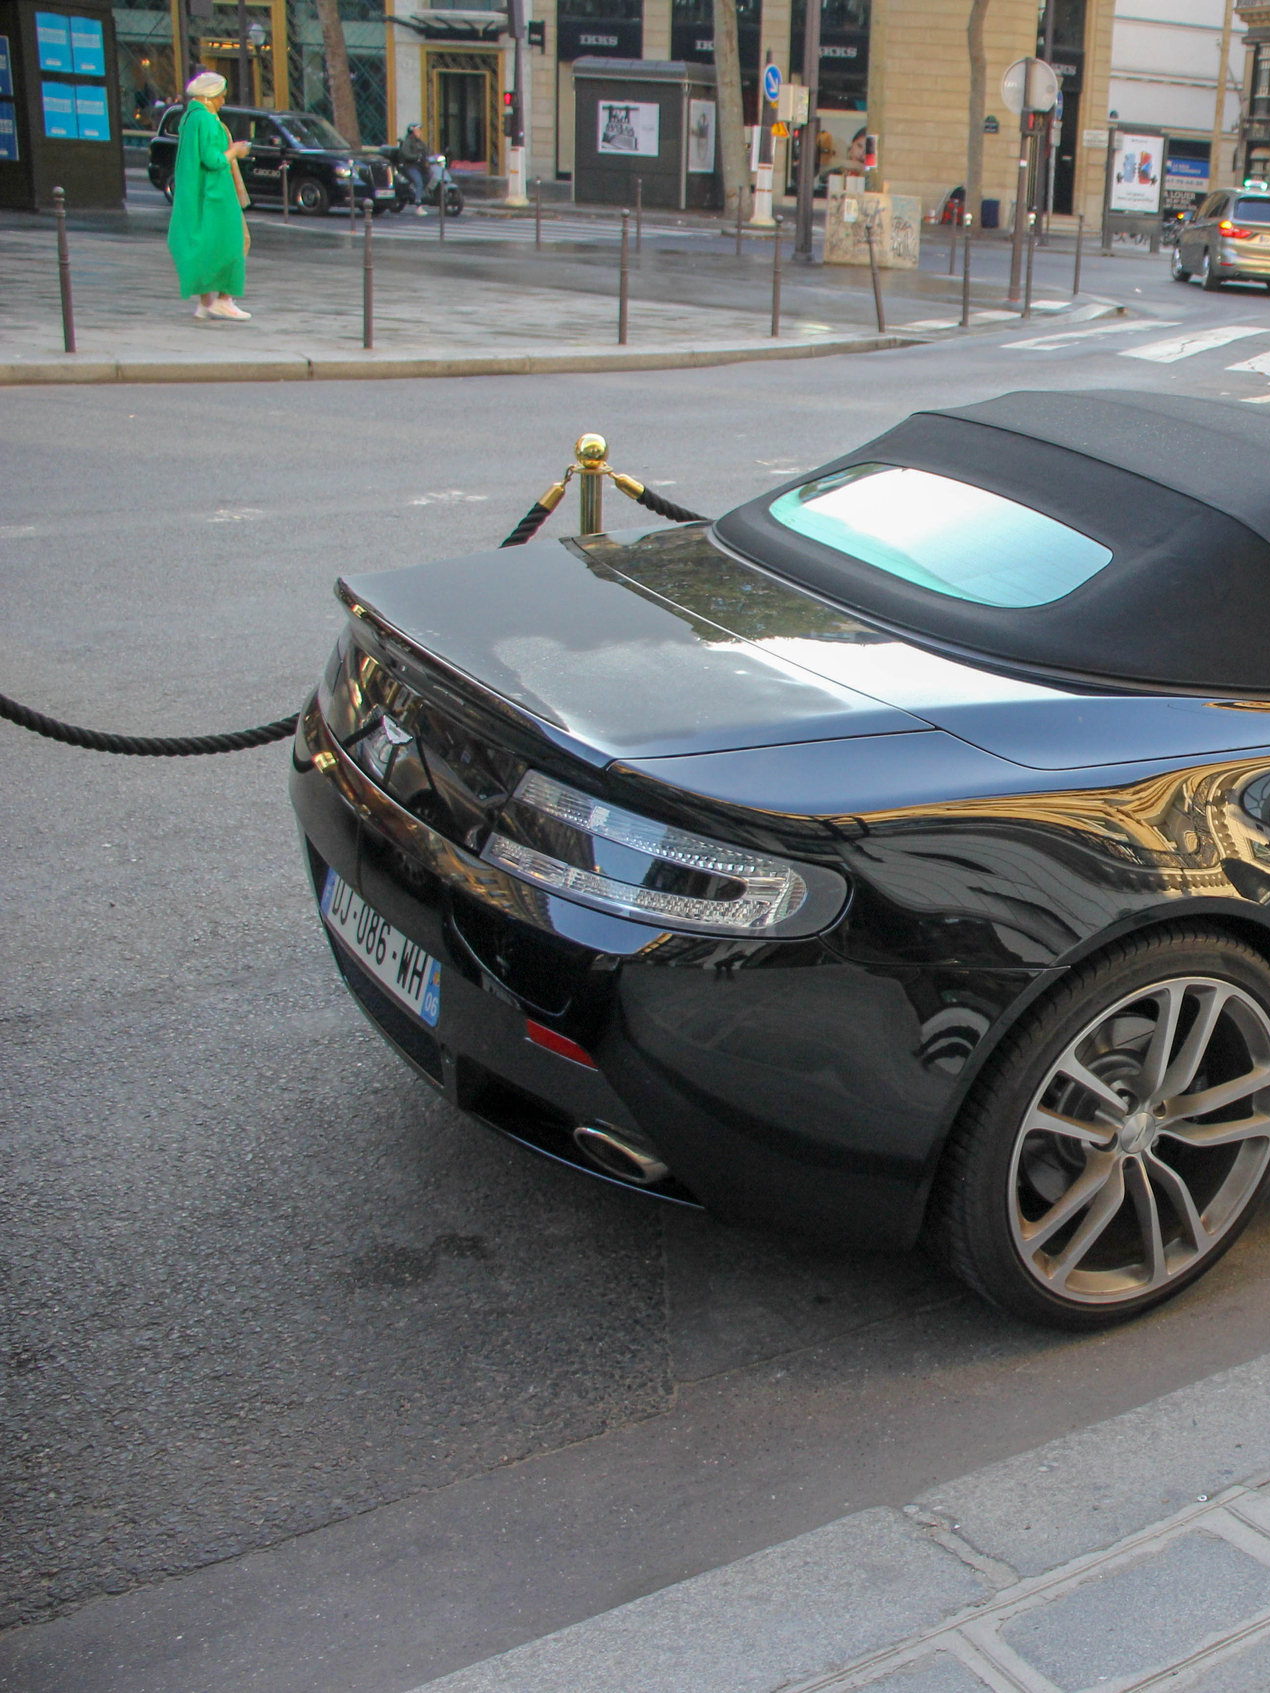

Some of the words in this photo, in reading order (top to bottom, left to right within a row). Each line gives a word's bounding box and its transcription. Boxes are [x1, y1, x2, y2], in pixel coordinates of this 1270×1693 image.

[580, 34, 618, 46] IKKS
[696, 40, 715, 50] IK
[424, 992, 438, 1017] 06
